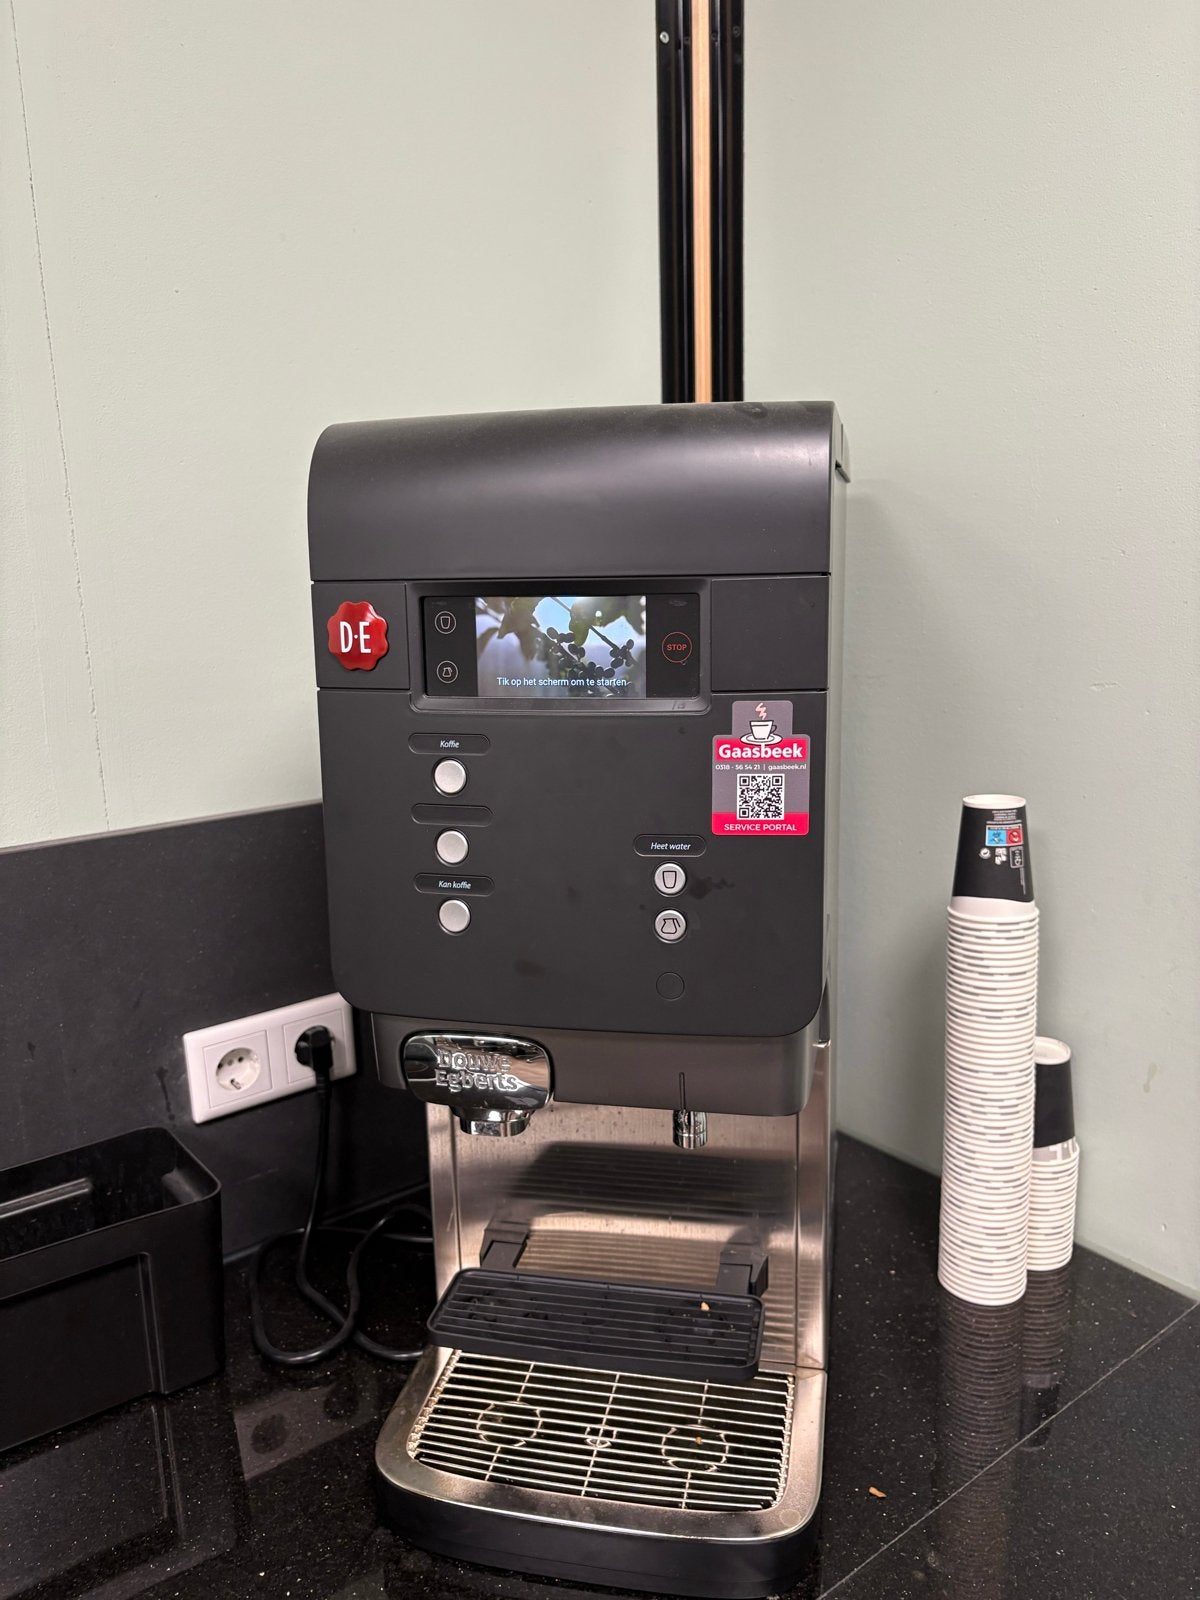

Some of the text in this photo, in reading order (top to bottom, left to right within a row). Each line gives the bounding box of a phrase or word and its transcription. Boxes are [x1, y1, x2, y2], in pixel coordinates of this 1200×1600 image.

[666, 643, 688, 651] STOP
[496, 677, 510, 686] Tik
[510, 679, 522, 688] op
[523, 677, 537, 686] het
[538, 677, 569, 686] scherm
[586, 678, 595, 686] te
[596, 678, 627, 686] starten
[439, 740, 460, 749] Koffie
[718, 743, 803, 759] Gaasbeek
[768, 763, 807, 771] gaasbeek.nl
[724, 823, 797, 831] SERVICE PORTAL
[650, 842, 668, 850] Heet
[438, 880, 472, 889] Kan koffie
[435, 1069, 519, 1092] Egberts
